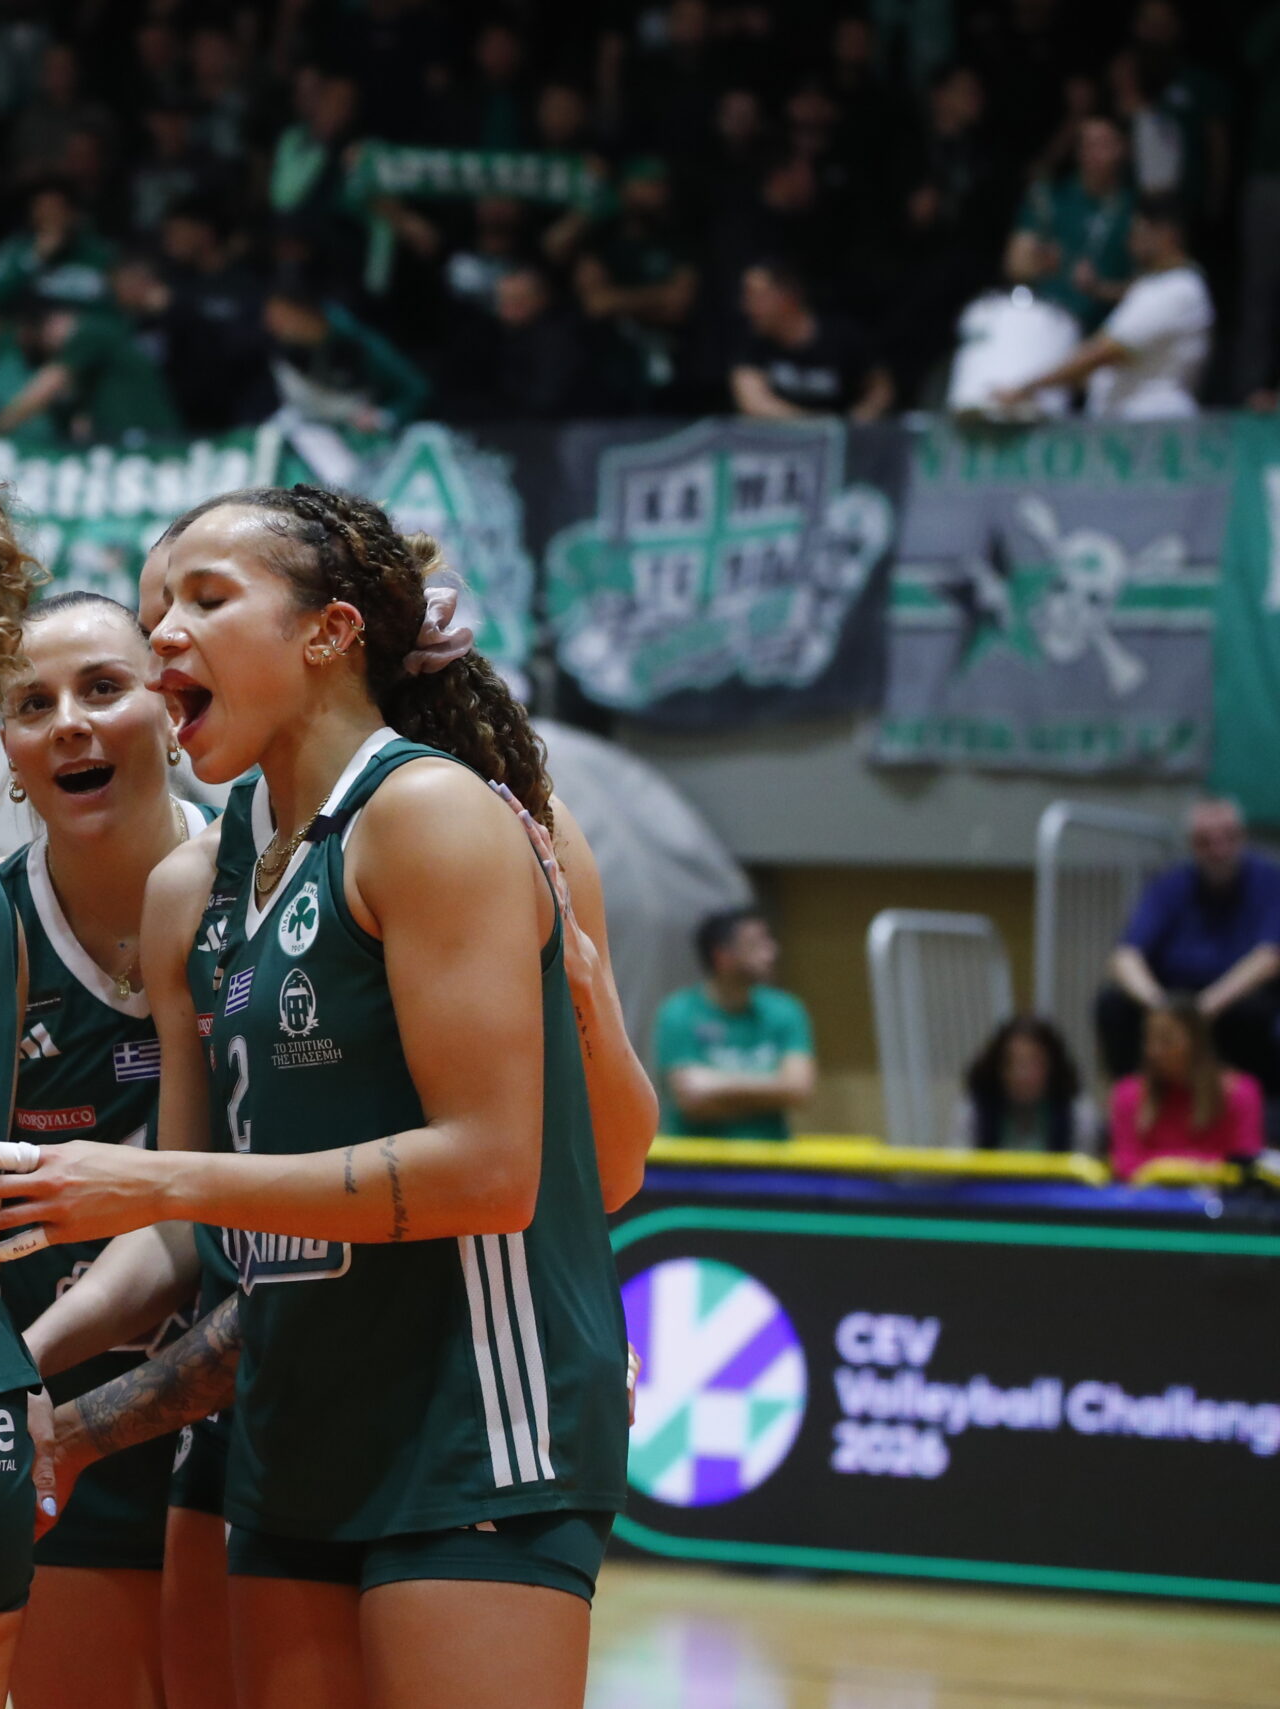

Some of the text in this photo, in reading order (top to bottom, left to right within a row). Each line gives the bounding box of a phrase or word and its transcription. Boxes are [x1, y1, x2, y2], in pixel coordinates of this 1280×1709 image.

[271, 1055, 290, 1066] ΤΗΣ
[292, 1049, 343, 1064] ΓΙΑΣΕΜΗ
[273, 1039, 333, 1054] ΤΟ ΣΠΙΤΙΚΟ
[227, 1034, 251, 1153] 2
[835, 1311, 942, 1367] CEV
[833, 1366, 1280, 1456] Volleyball Challeng
[831, 1419, 951, 1479] 2026
